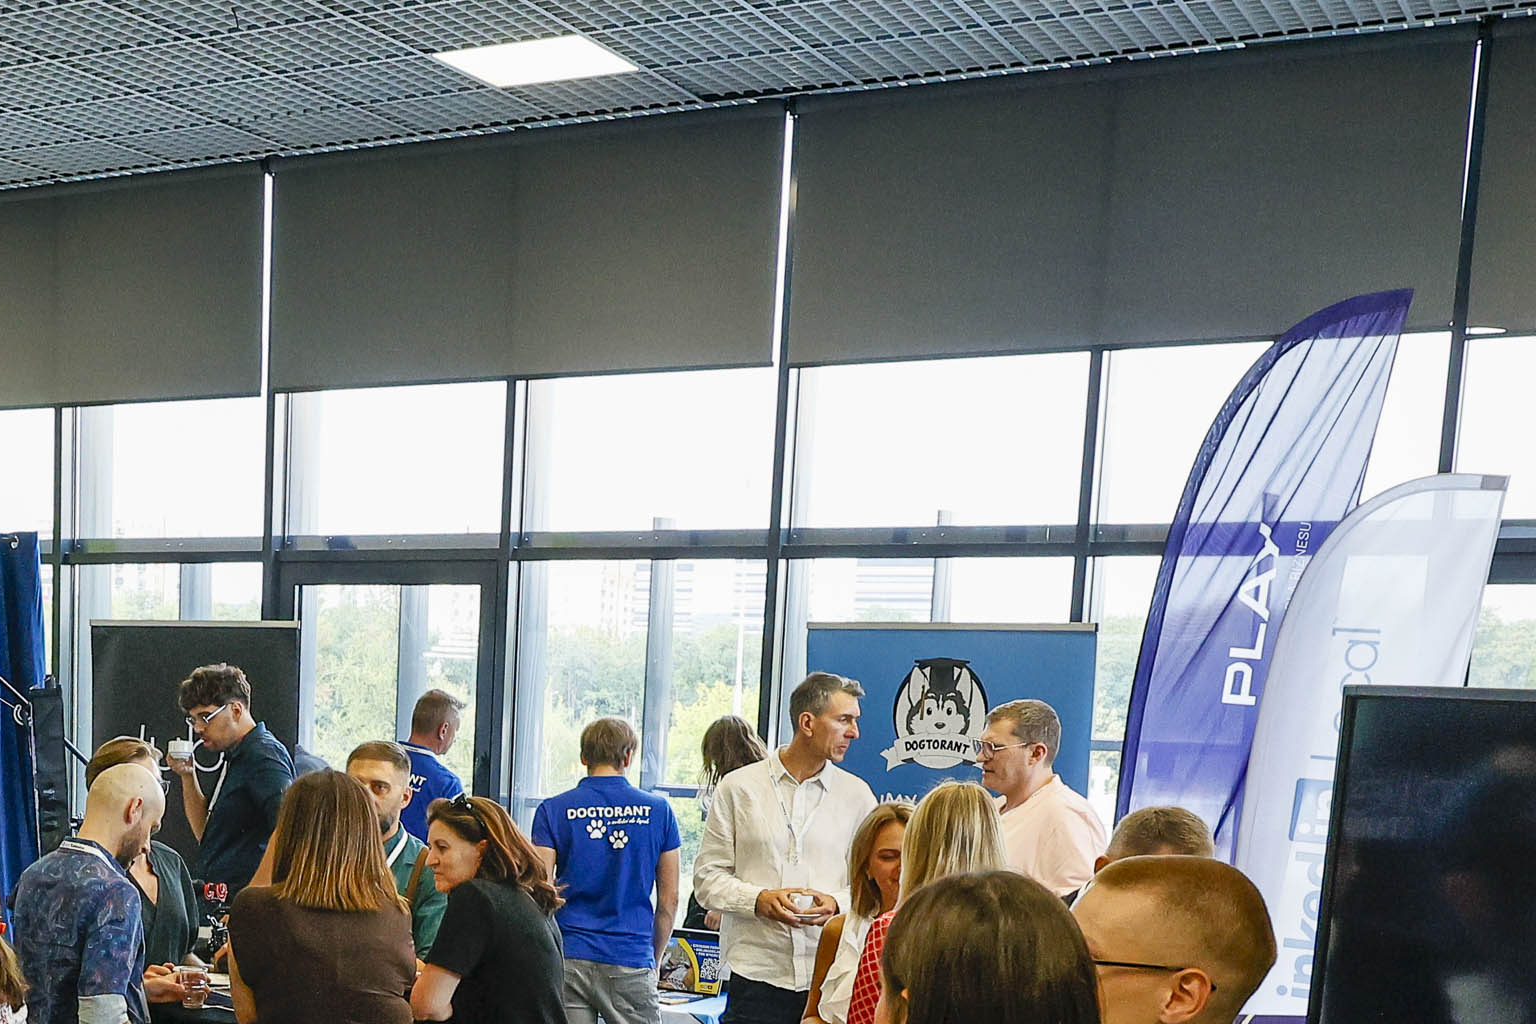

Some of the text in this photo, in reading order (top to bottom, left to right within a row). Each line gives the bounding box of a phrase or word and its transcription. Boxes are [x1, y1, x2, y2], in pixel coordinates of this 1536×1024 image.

[1289, 521, 1312, 580] BIZNESU
[1221, 522, 1280, 706] PLAY
[904, 738, 971, 755] DOGTORANT
[566, 805, 652, 820] DOGTORANT
